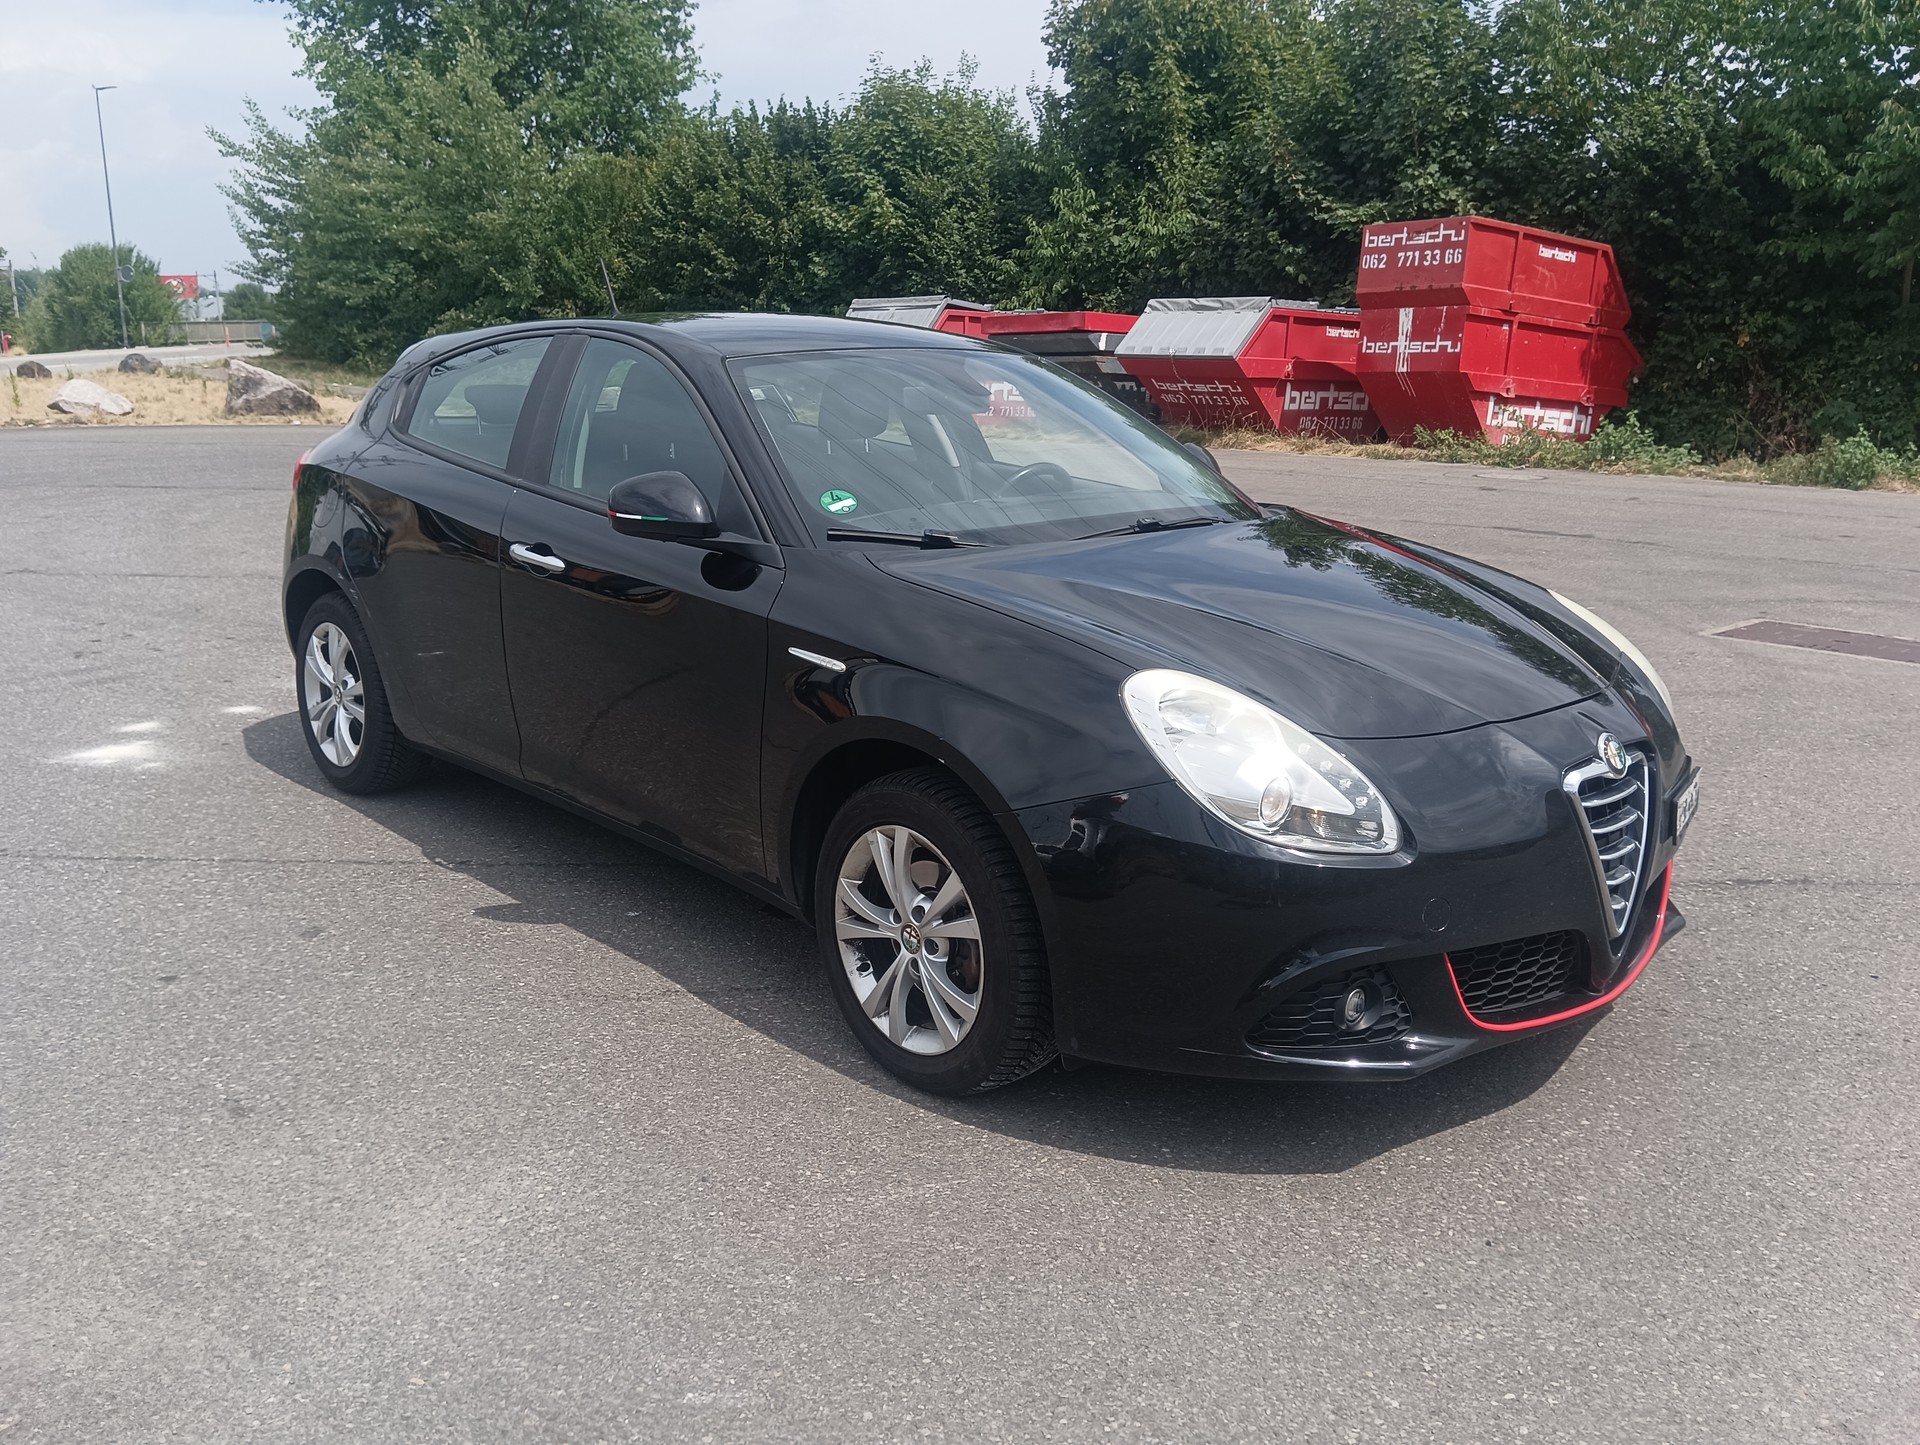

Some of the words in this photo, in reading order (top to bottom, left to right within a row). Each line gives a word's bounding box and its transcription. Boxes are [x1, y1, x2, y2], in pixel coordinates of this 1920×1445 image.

[1364, 221, 1466, 248] bertschi
[1361, 253, 1388, 270] 062
[1397, 250, 1421, 268] 771
[1423, 249, 1441, 267] 33
[1444, 248, 1463, 265] 66
[1538, 243, 1577, 263] bertschi
[1361, 333, 1462, 354] bertschi
[1151, 378, 1243, 393] bertschi
[1160, 393, 1186, 404] 062
[1190, 395, 1214, 405] 771
[1213, 395, 1232, 406] 33
[1300, 416, 1318, 431] 062
[830, 491, 843, 502] 4
